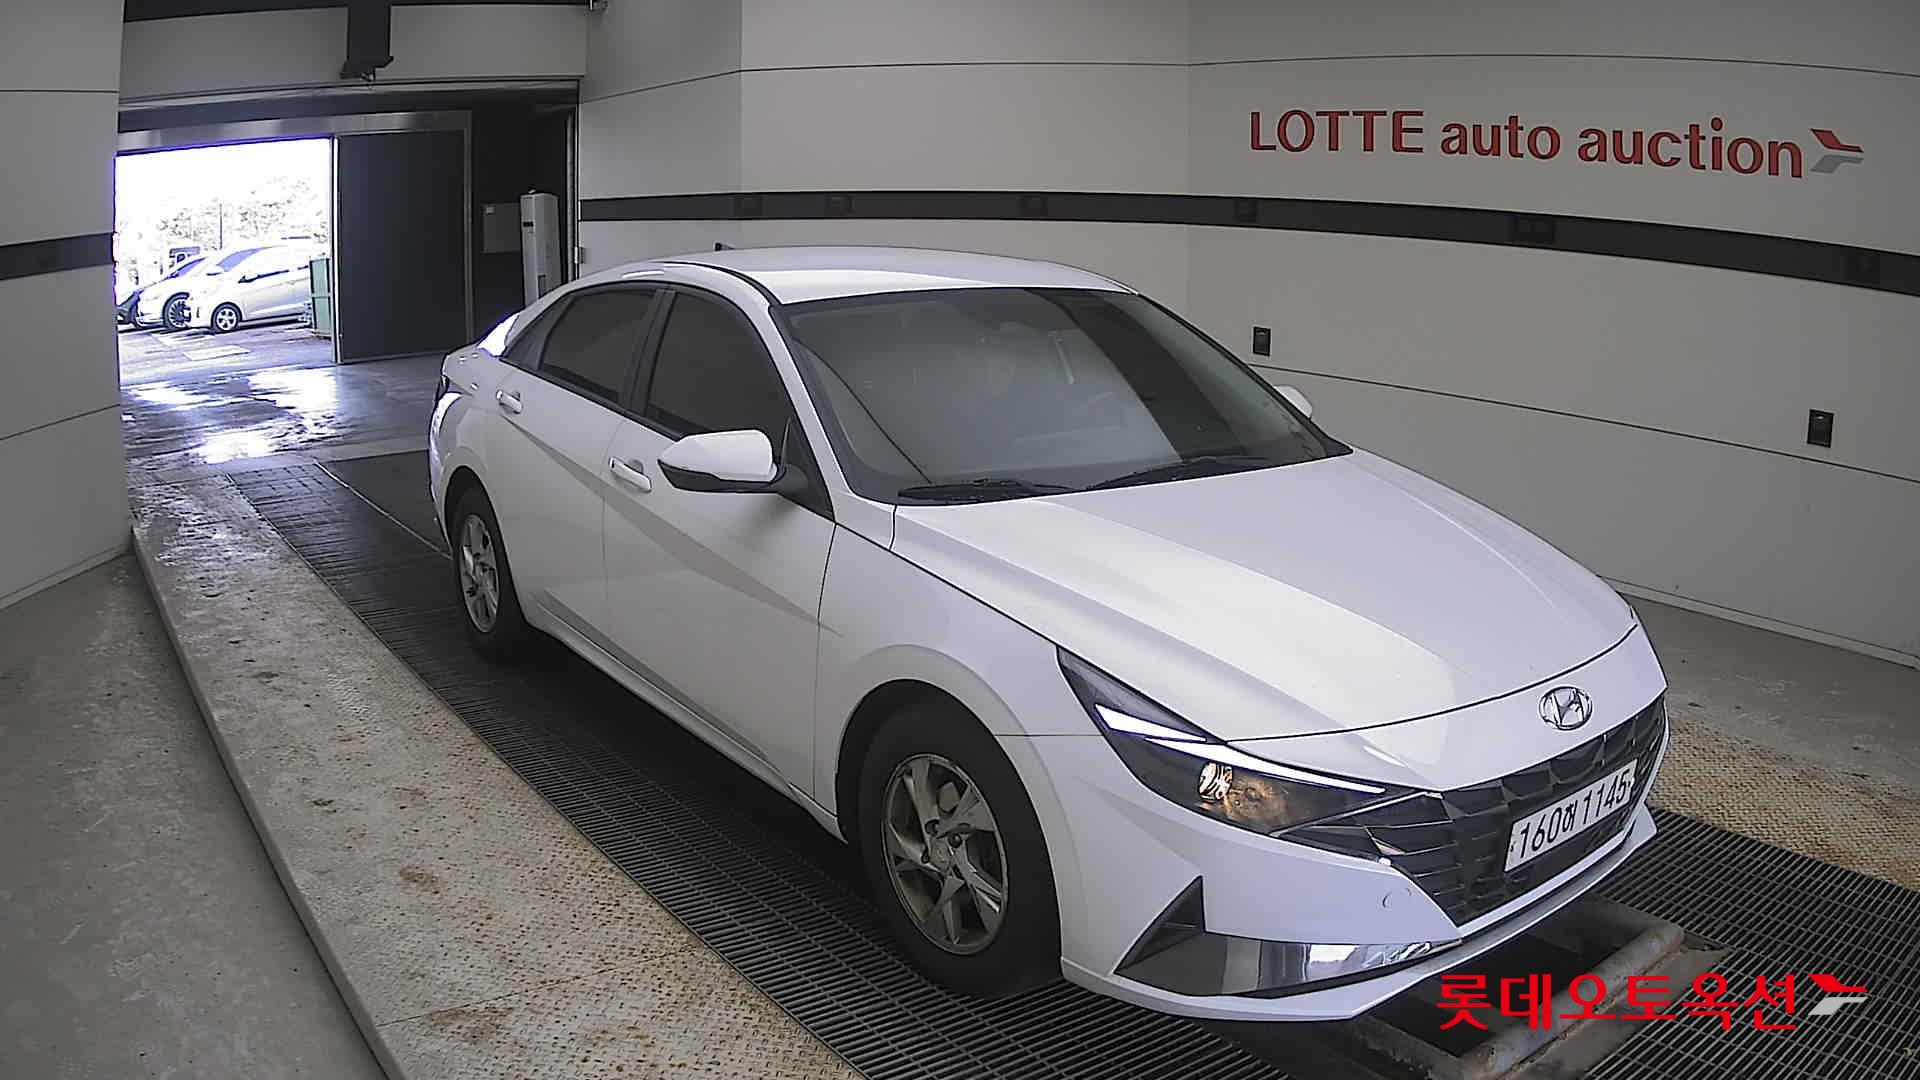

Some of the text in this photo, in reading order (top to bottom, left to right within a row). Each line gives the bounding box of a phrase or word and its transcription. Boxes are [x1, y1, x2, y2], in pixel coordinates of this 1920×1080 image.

[1250, 110, 1803, 178] LOTTE auto auction
[1583, 768, 1630, 825] 1145
